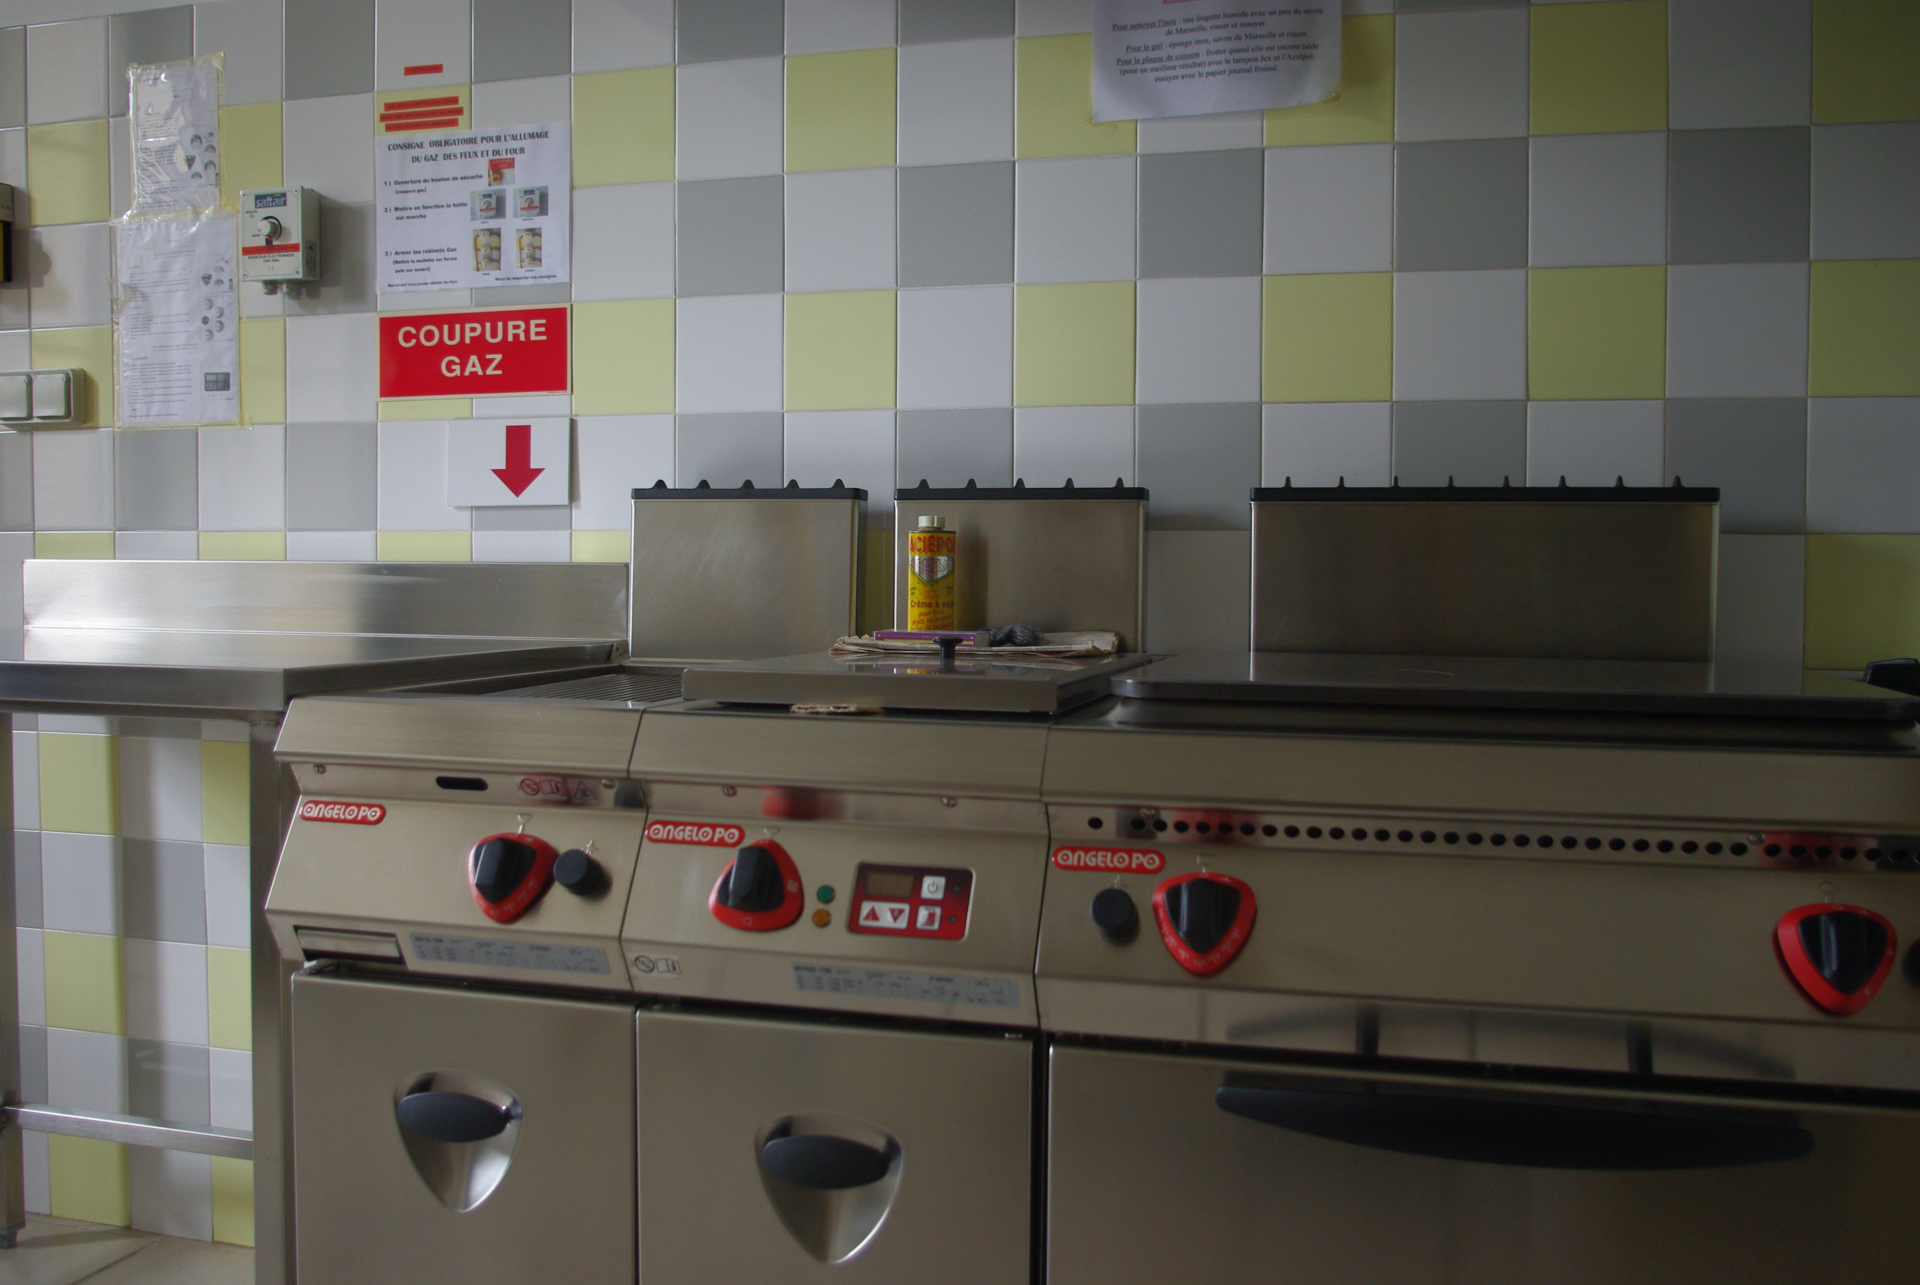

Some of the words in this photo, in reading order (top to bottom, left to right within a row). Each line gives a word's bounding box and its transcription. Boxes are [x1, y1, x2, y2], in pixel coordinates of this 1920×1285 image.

[1175, 25, 1208, 35] Marseille,
[1152, 42, 1163, 51] gril
[1169, 41, 1192, 49] éponge
[1244, 32, 1277, 41] Marseille
[1116, 58, 1132, 66] Pour
[1142, 56, 1164, 65] plaque
[1165, 54, 1173, 62] de
[1228, 46, 1250, 55] quand
[1150, 65, 1177, 73] meilleur
[1179, 61, 1206, 70] résultat)
[1205, 70, 1227, 78] papier
[1228, 67, 1253, 76] journal
[388, 141, 425, 151] CONSIGNE
[429, 137, 479, 148] OBLIGATOIRE
[480, 135, 502, 144] POUR
[504, 130, 549, 142] L'ALLUMAGE
[411, 155, 422, 163] DU
[424, 154, 439, 162] GAZ
[443, 152, 458, 160] DES
[460, 150, 479, 159] FEUX
[481, 150, 489, 158] ET
[492, 148, 503, 157] DU
[505, 146, 525, 156] FOUR
[256, 195, 286, 208] saftair
[398, 319, 547, 348] COUPURE
[441, 354, 503, 377] GAZ
[910, 600, 932, 608] Crème
[935, 599, 939, 608] à
[358, 806, 381, 820] PO
[714, 827, 739, 843] PO
[1131, 853, 1159, 869] PO
